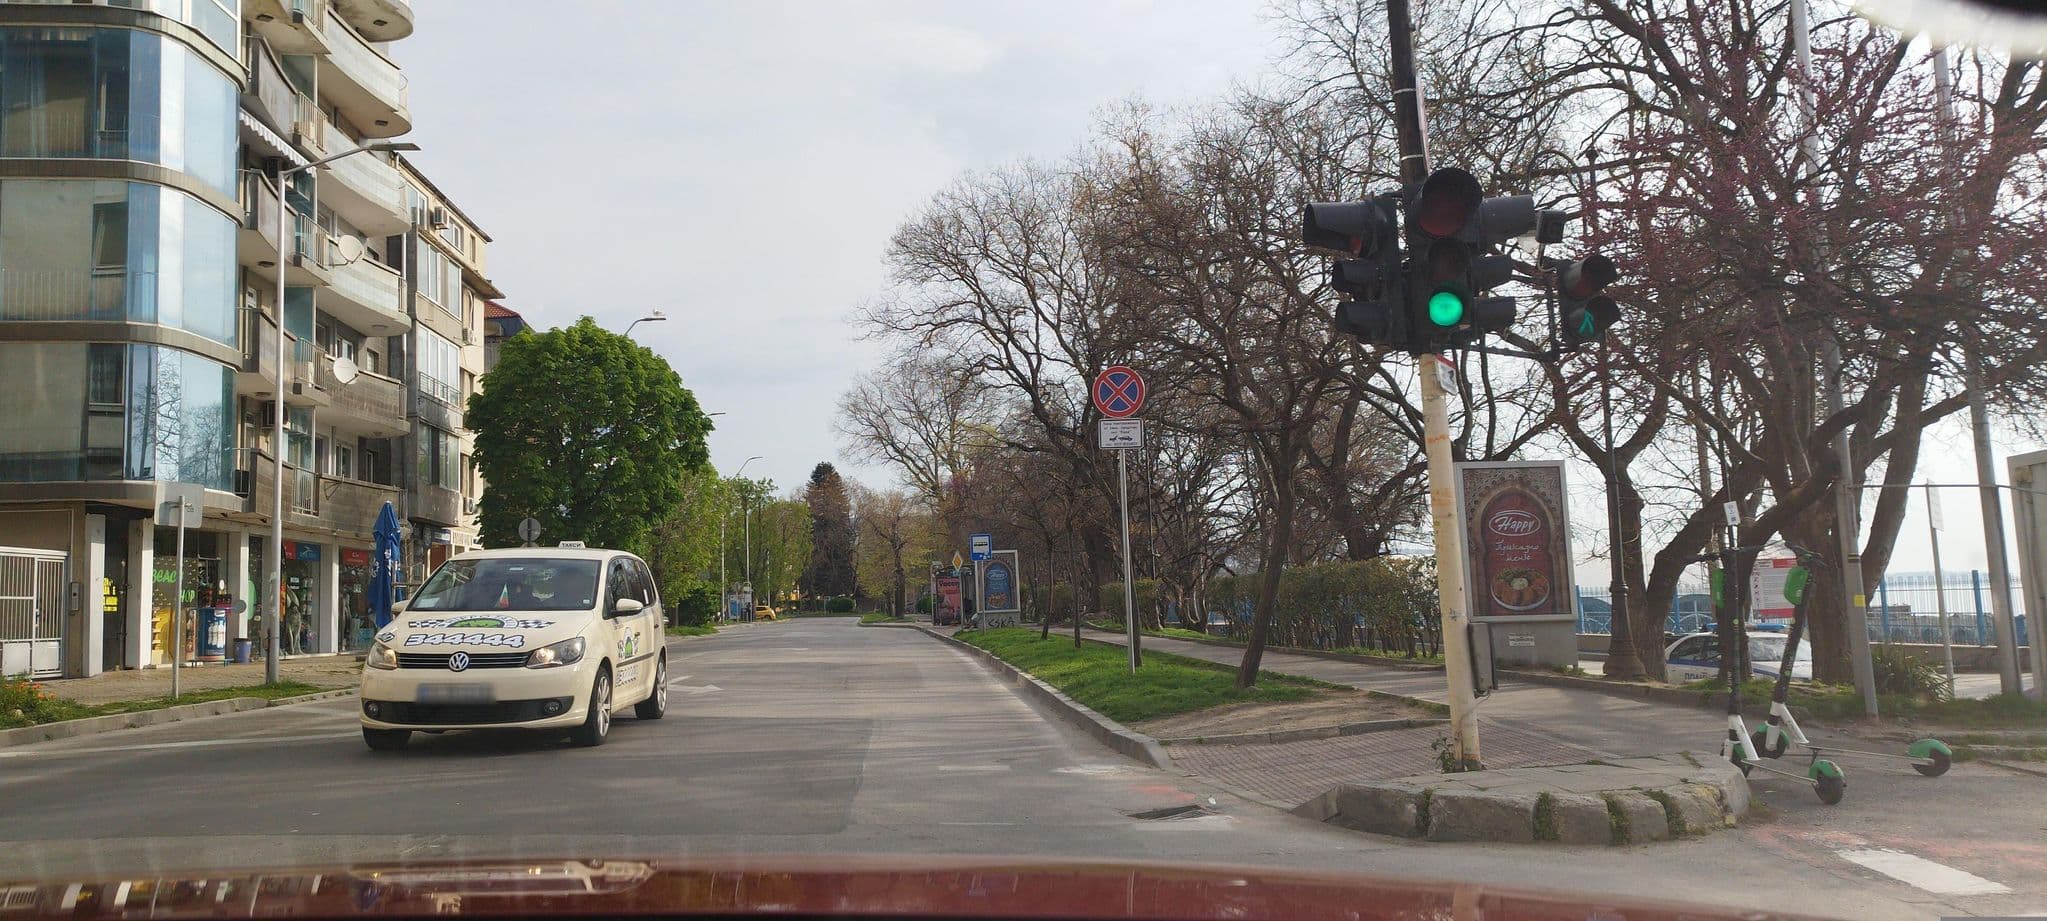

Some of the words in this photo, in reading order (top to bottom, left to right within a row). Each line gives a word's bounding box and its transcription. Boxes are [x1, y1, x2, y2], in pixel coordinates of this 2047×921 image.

[1495, 516, 1534, 532] Happy
[152, 569, 177, 584] BEAC
[180, 588, 196, 603] HOP
[404, 633, 525, 648] 344444
